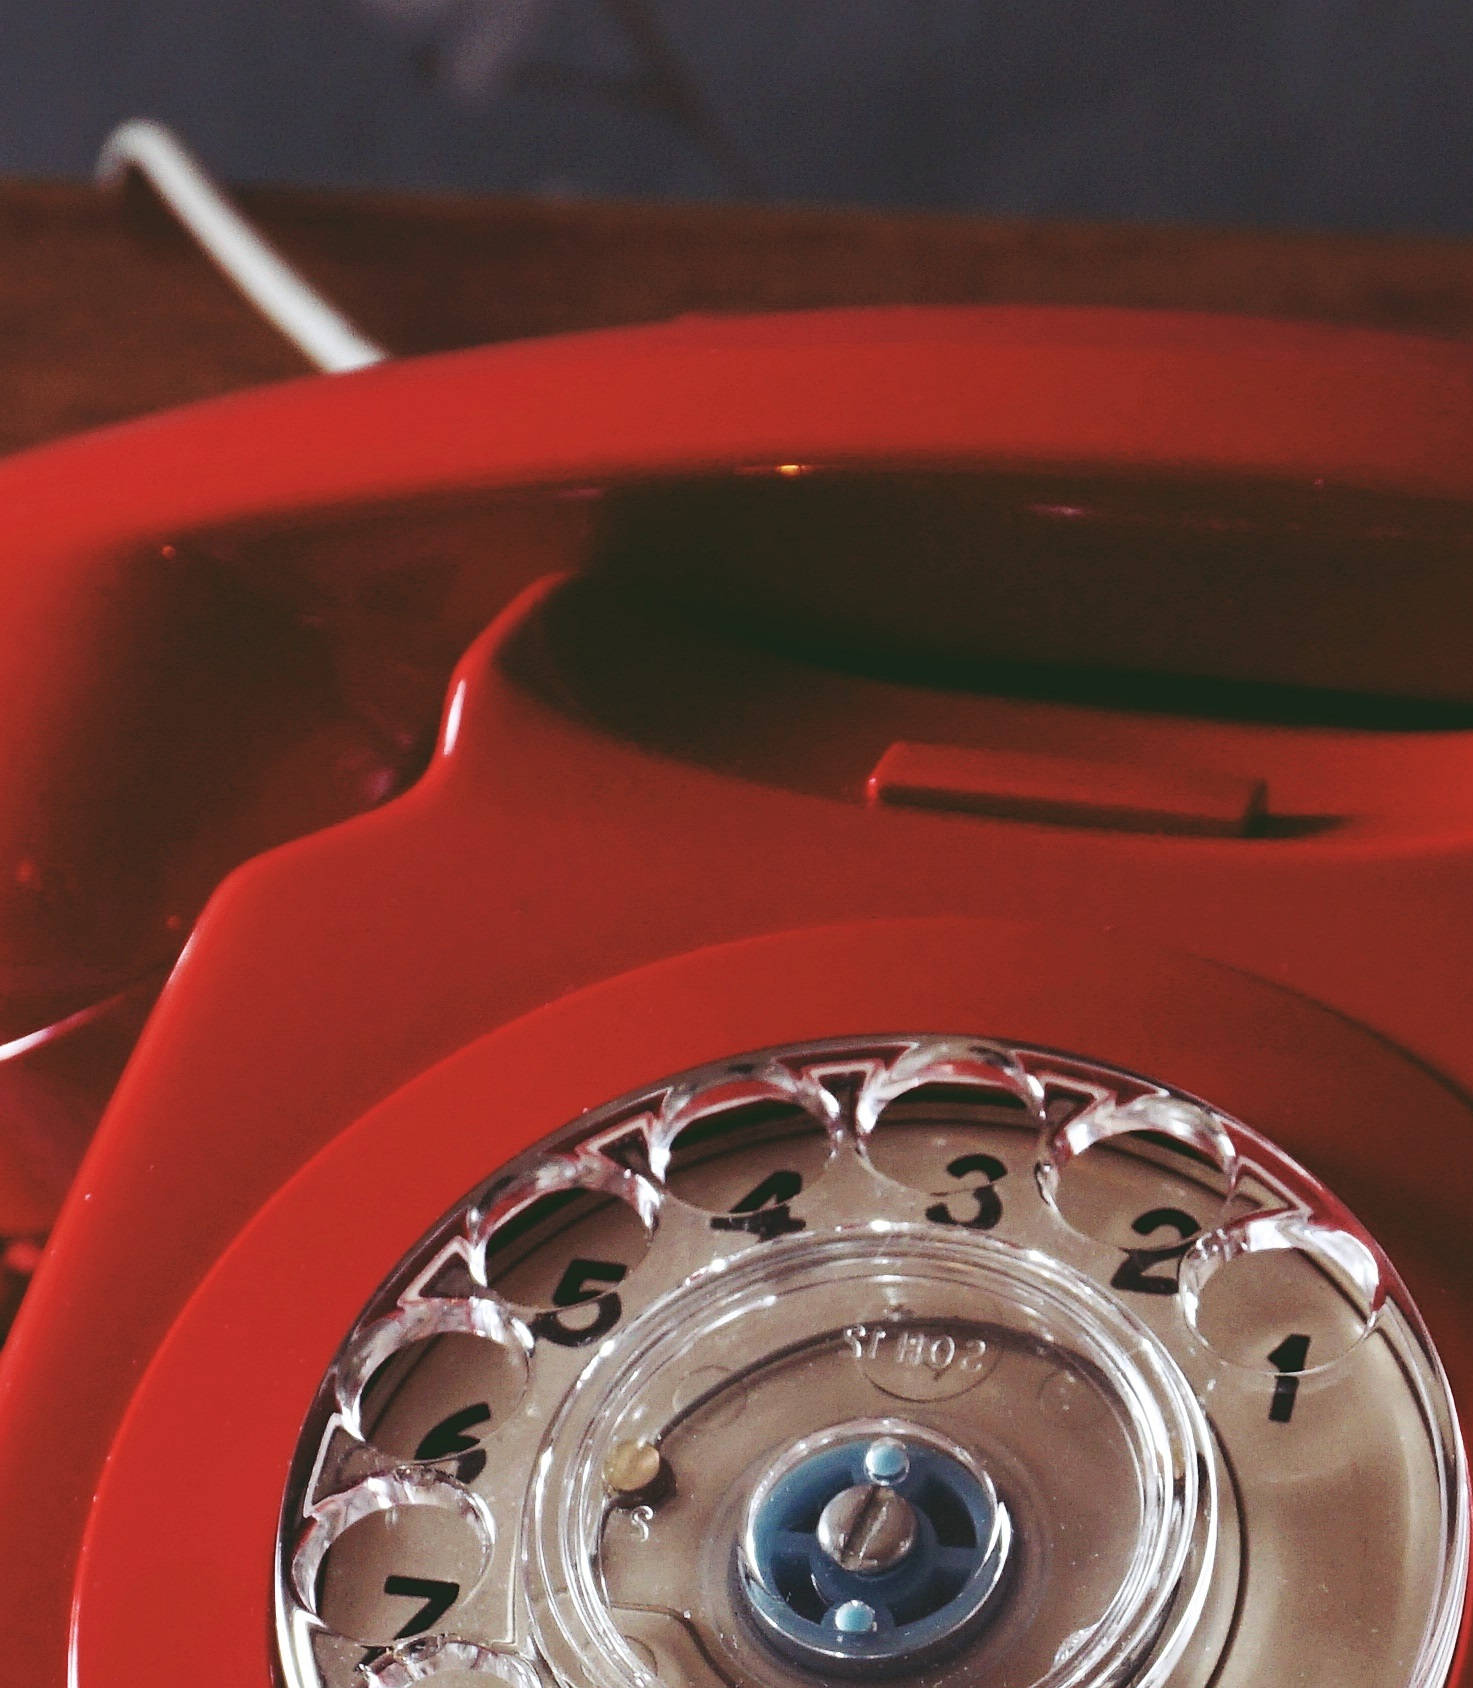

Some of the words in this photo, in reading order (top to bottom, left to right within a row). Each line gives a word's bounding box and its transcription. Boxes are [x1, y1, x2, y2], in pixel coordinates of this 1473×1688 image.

[709, 1169, 807, 1241] 4
[924, 1152, 1009, 1231] 3
[1109, 1206, 1202, 1296] 2
[530, 1258, 628, 1348] 5
[1266, 1333, 1312, 1423] 1
[412, 1401, 492, 1485] 6
[354, 1574, 460, 1673] 7
